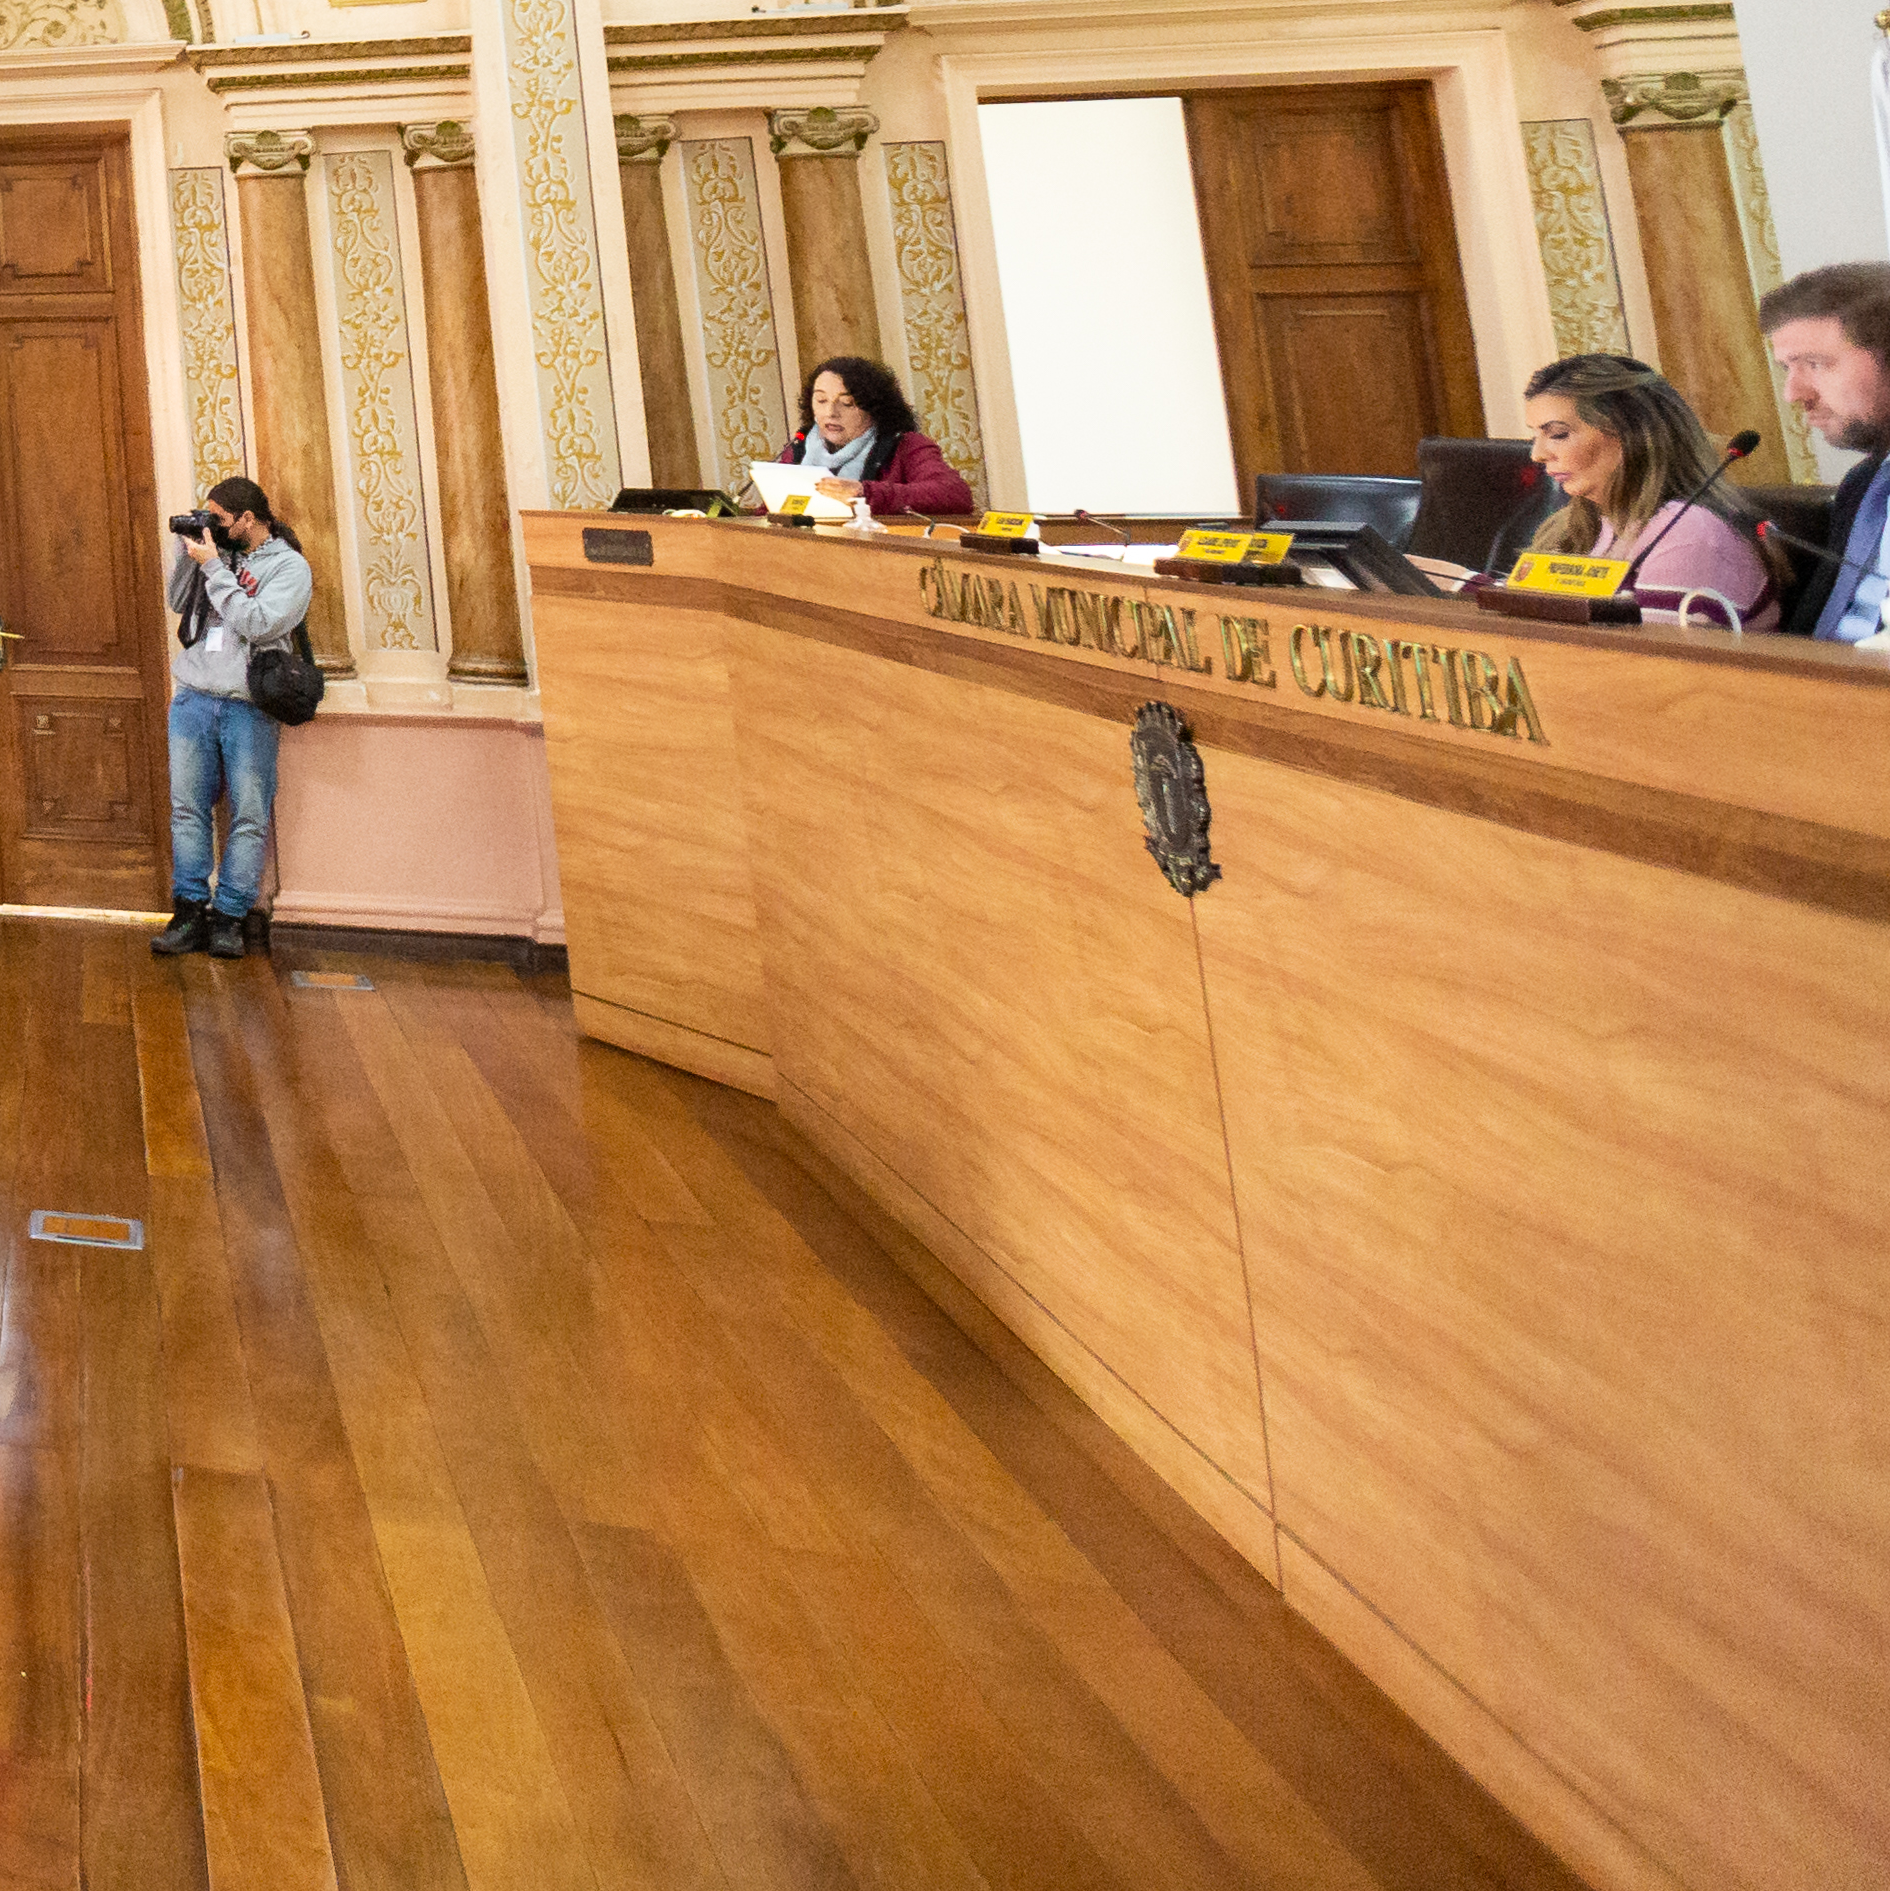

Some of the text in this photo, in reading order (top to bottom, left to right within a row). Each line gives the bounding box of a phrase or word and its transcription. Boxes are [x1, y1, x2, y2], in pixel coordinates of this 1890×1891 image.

[920, 556, 1551, 747] CÂMARA MUNICIPAL DE CURITIBA
